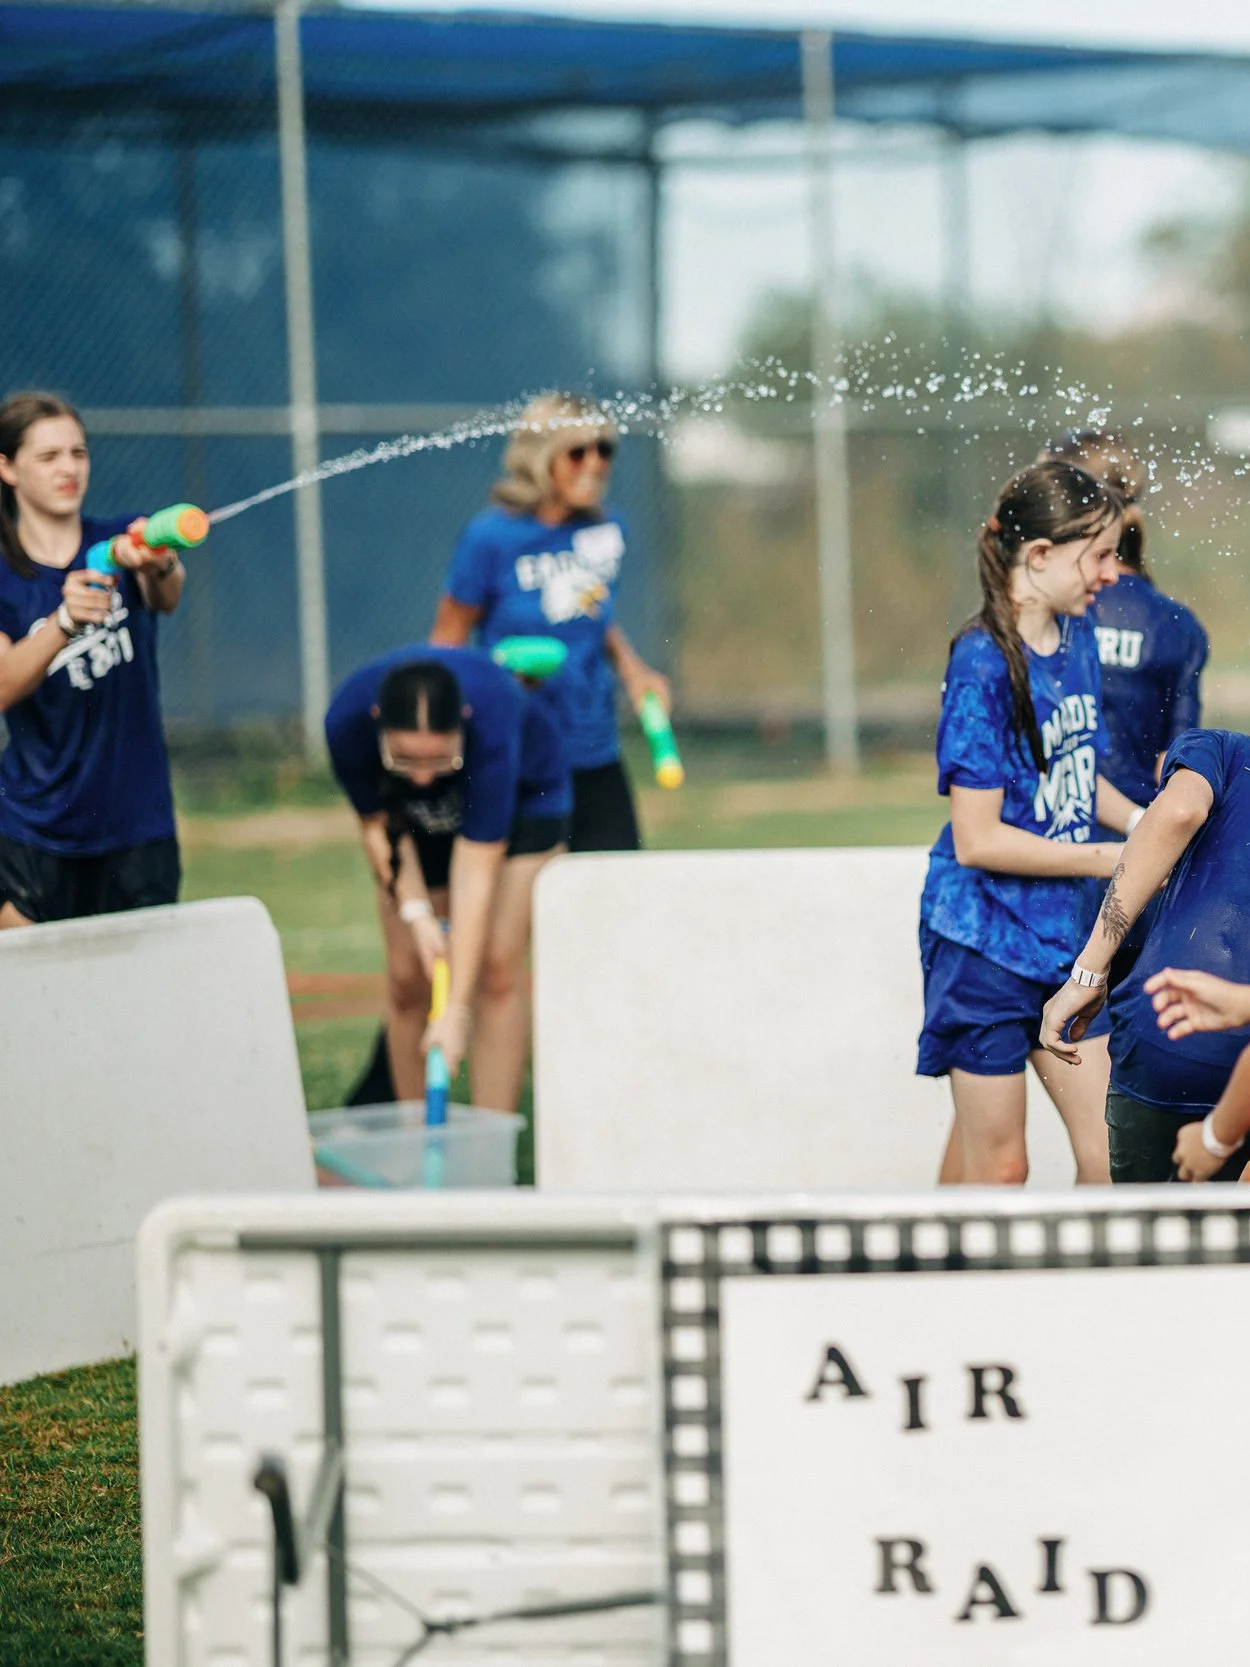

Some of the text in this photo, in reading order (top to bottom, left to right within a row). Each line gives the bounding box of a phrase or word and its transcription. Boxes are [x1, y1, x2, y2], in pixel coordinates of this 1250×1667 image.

[1094, 626, 1144, 668] RU
[806, 1345, 1026, 1431] AIR
[875, 1537, 1150, 1625] RAID
